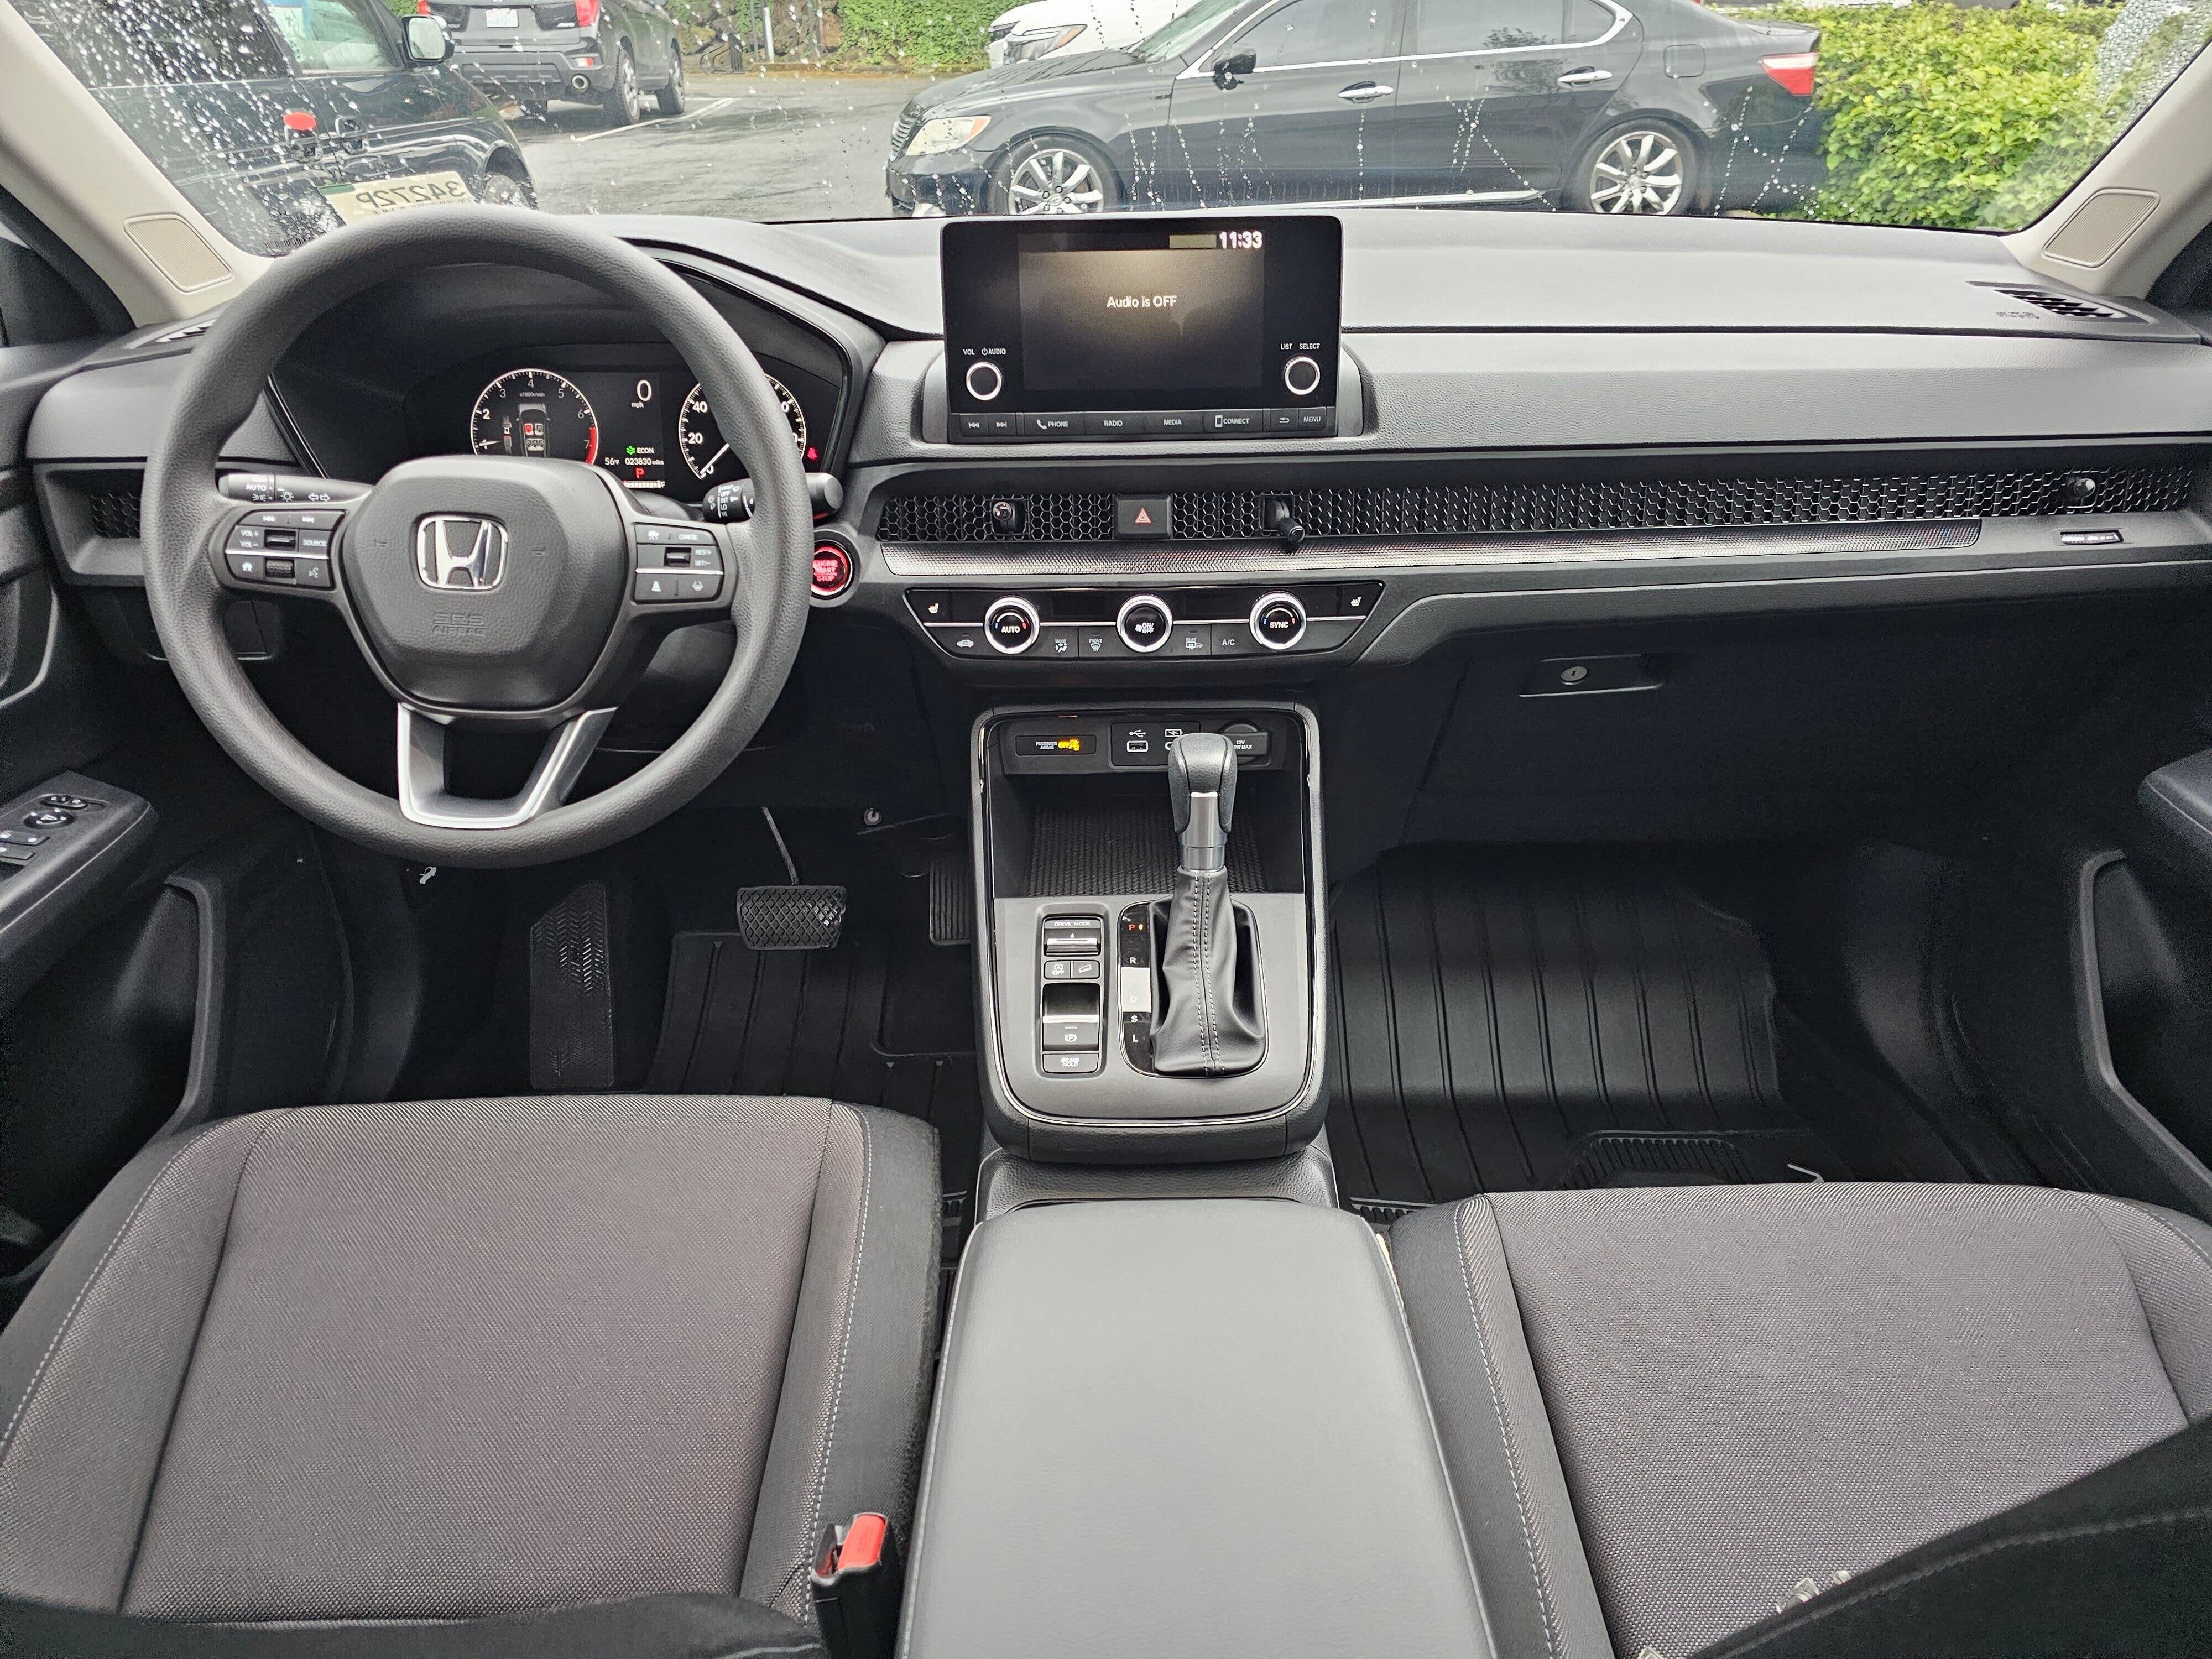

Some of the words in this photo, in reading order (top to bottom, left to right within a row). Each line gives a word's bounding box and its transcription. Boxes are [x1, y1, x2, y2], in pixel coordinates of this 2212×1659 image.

[1219, 231, 1262, 249] 11:33
[1107, 296, 1139, 308] Audio
[1141, 296, 1151, 307] is
[1153, 295, 1177, 307] OFF
[527, 379, 534, 388] 4
[499, 389, 507, 398] 3
[558, 389, 565, 398] 5
[637, 380, 652, 401] 0
[692, 401, 708, 413] 40
[483, 408, 491, 420] 2
[577, 409, 584, 419] 6
[688, 432, 703, 444] 20
[624, 457, 651, 466] 023830
[635, 467, 645, 478] P
[246, 483, 267, 492] AUTO
[302, 539, 327, 547] SOURCE
[1270, 620, 1289, 629] SYNC
